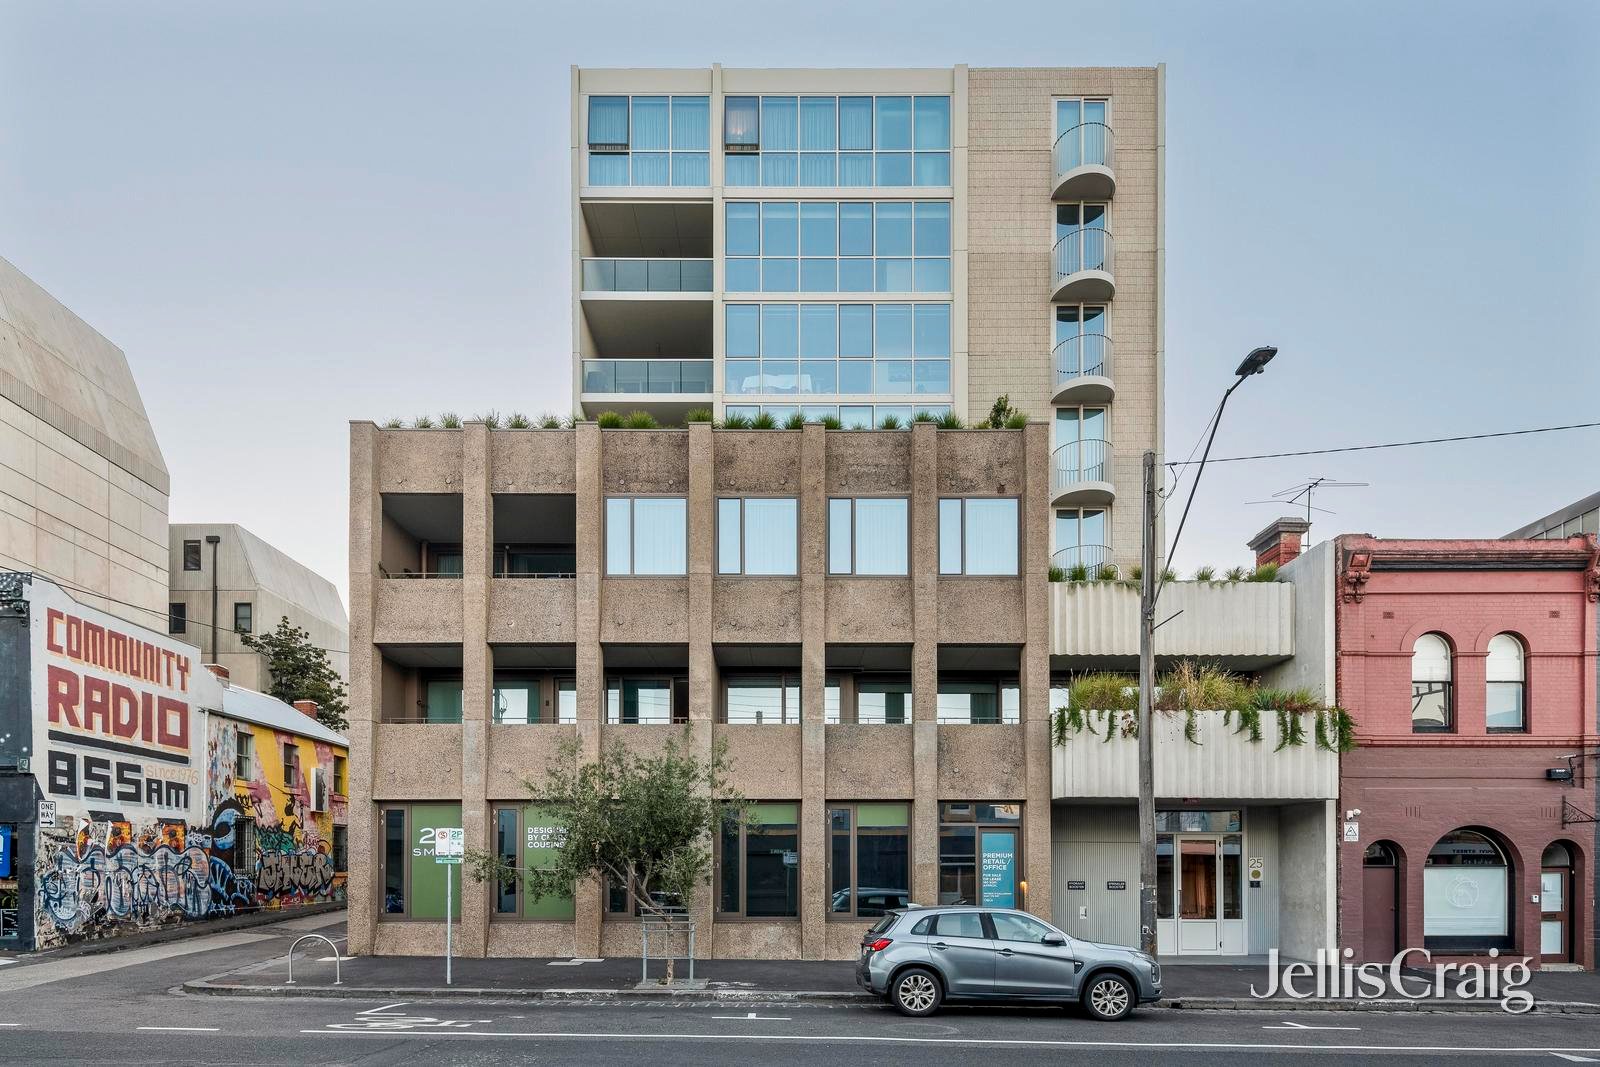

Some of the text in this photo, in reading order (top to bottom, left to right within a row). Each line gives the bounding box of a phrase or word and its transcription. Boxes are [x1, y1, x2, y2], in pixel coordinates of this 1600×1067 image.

[46, 607, 190, 691] COMMUNITY
[47, 664, 190, 750] RADIO
[178, 767, 200, 785] 1976
[41, 811, 54, 819] WAY
[451, 830, 463, 838] 2P
[527, 841, 566, 849] COUSINS
[1250, 858, 1263, 869] 25
